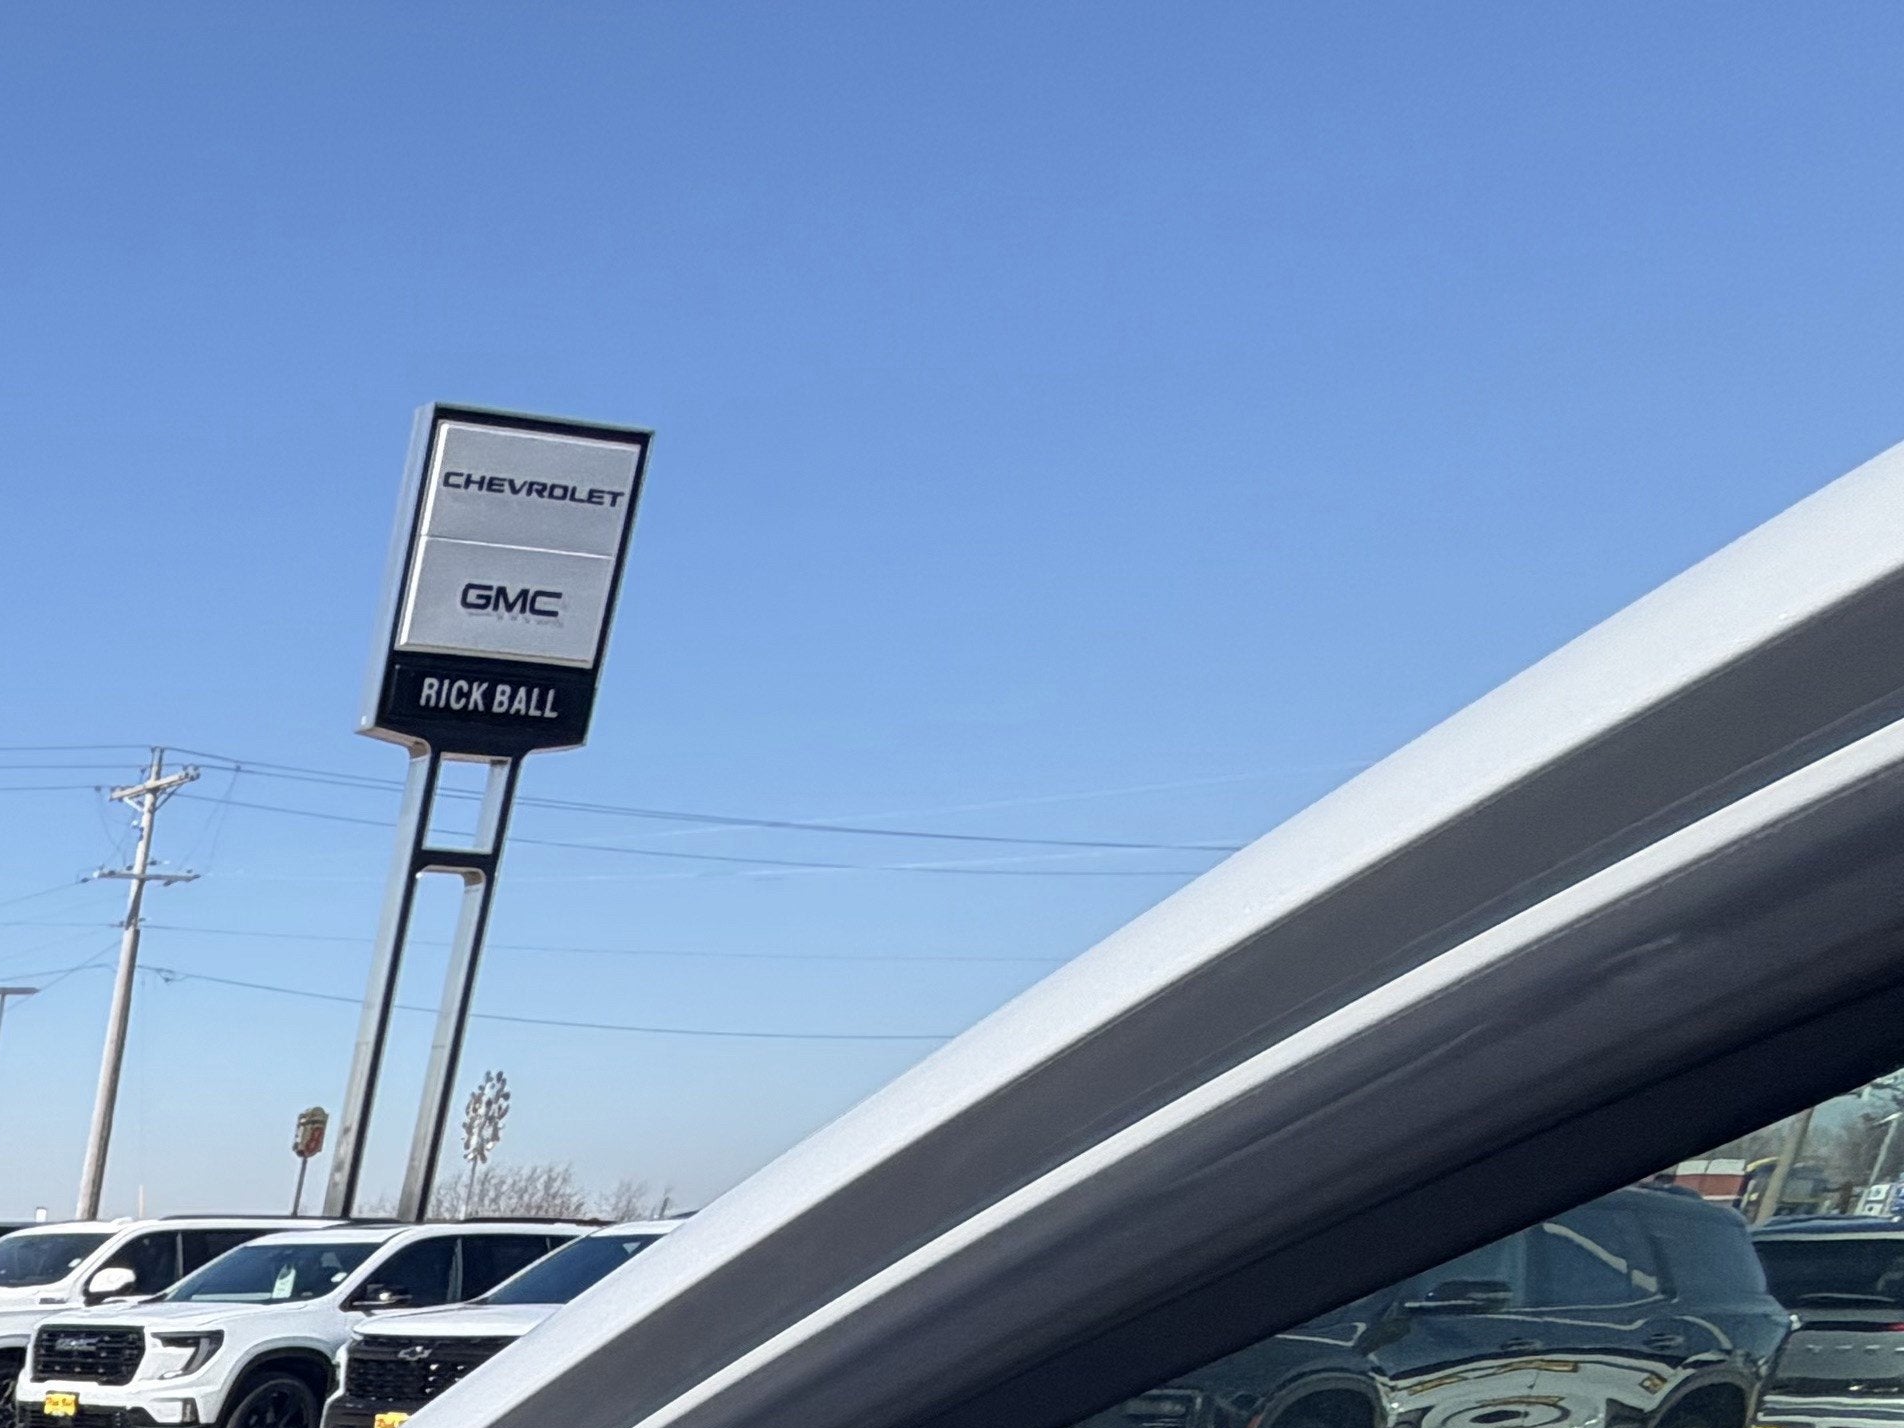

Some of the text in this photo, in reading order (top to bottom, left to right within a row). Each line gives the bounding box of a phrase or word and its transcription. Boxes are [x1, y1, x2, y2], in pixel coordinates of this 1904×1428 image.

[442, 471, 624, 507] CHEVROLET
[460, 583, 562, 618] GMC
[419, 677, 559, 718] RICK BALL
